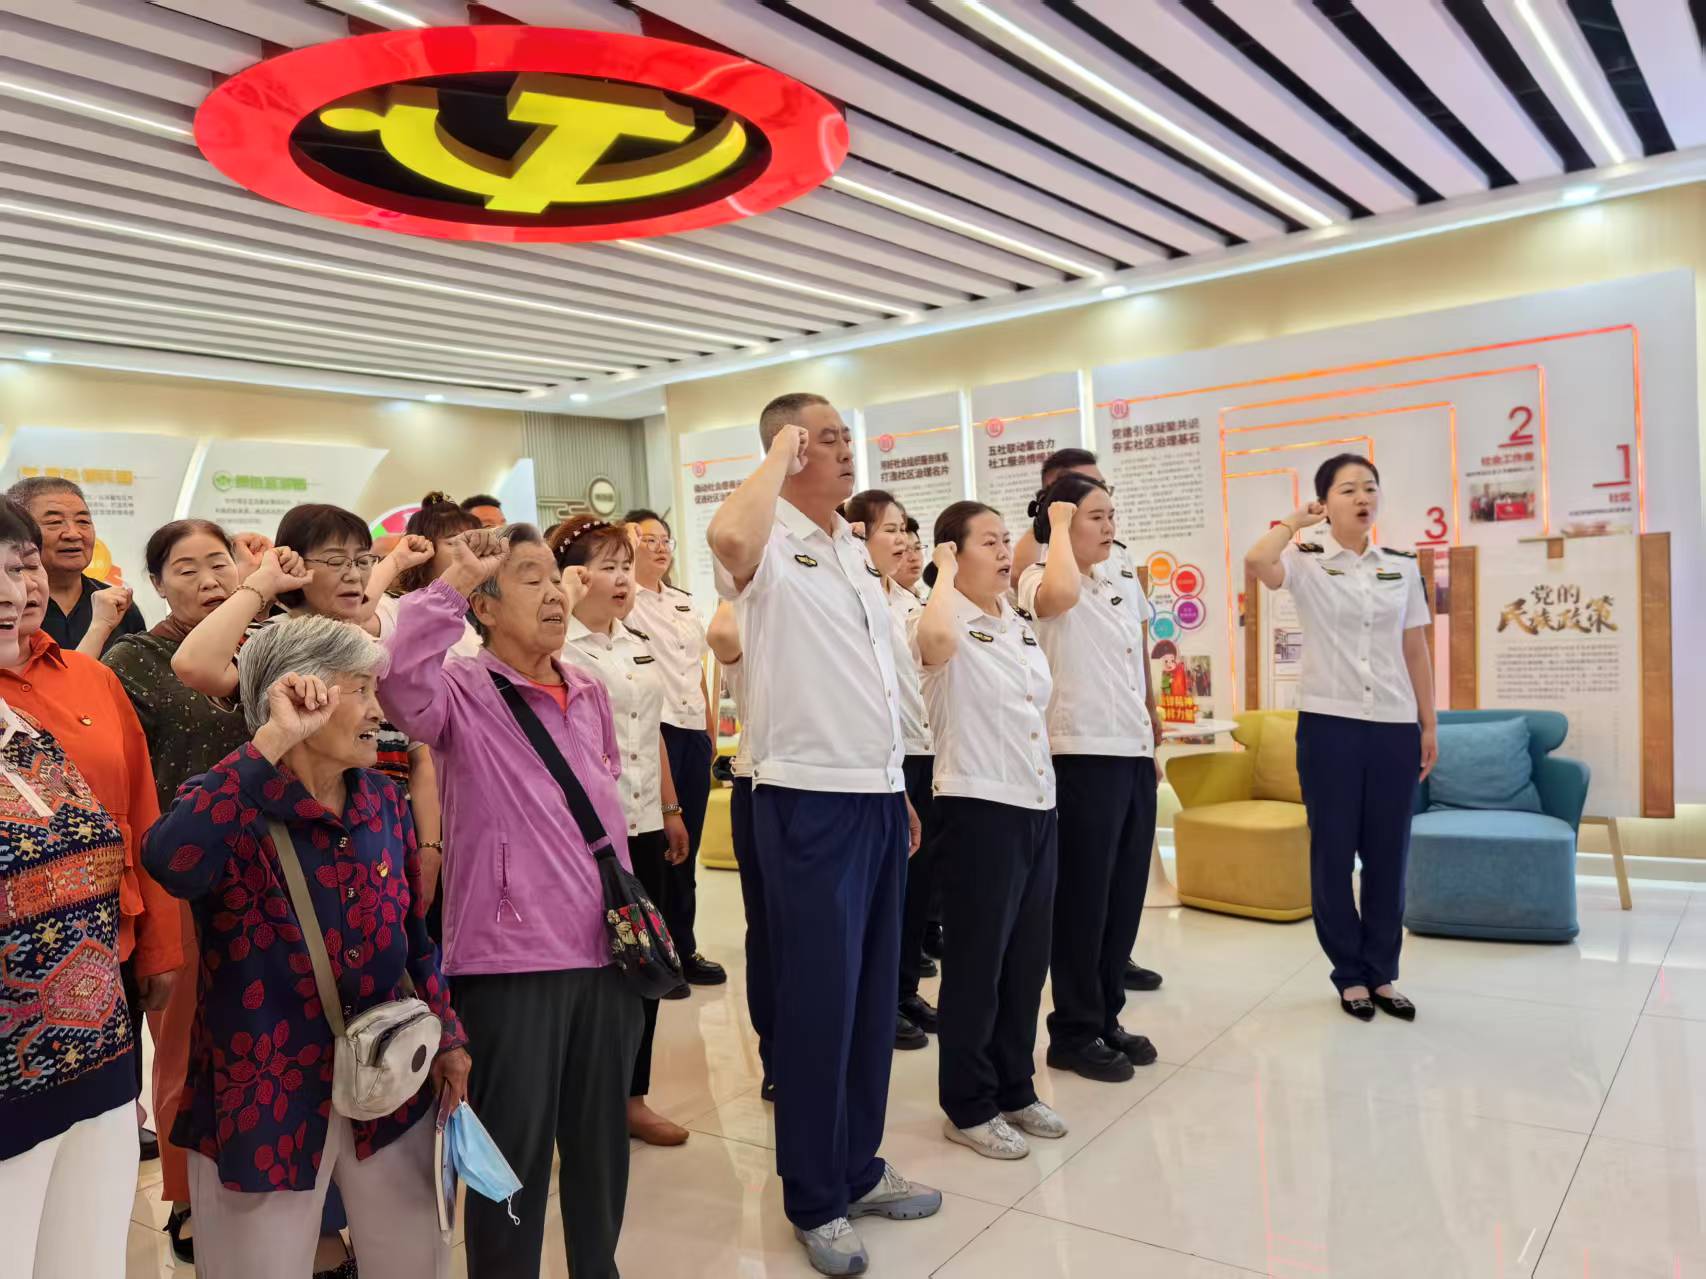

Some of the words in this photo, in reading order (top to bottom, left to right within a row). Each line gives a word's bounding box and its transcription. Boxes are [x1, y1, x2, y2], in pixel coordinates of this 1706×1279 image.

[1112, 418, 1199, 439] 党建引领凝聚共识
[1509, 406, 1533, 441] 2
[988, 438, 1055, 456] 五社联动聚合力
[1616, 444, 1630, 480] 1
[1425, 507, 1447, 539] 3
[1531, 584, 1581, 606] 党的
[1497, 595, 1618, 635] 民族政策
